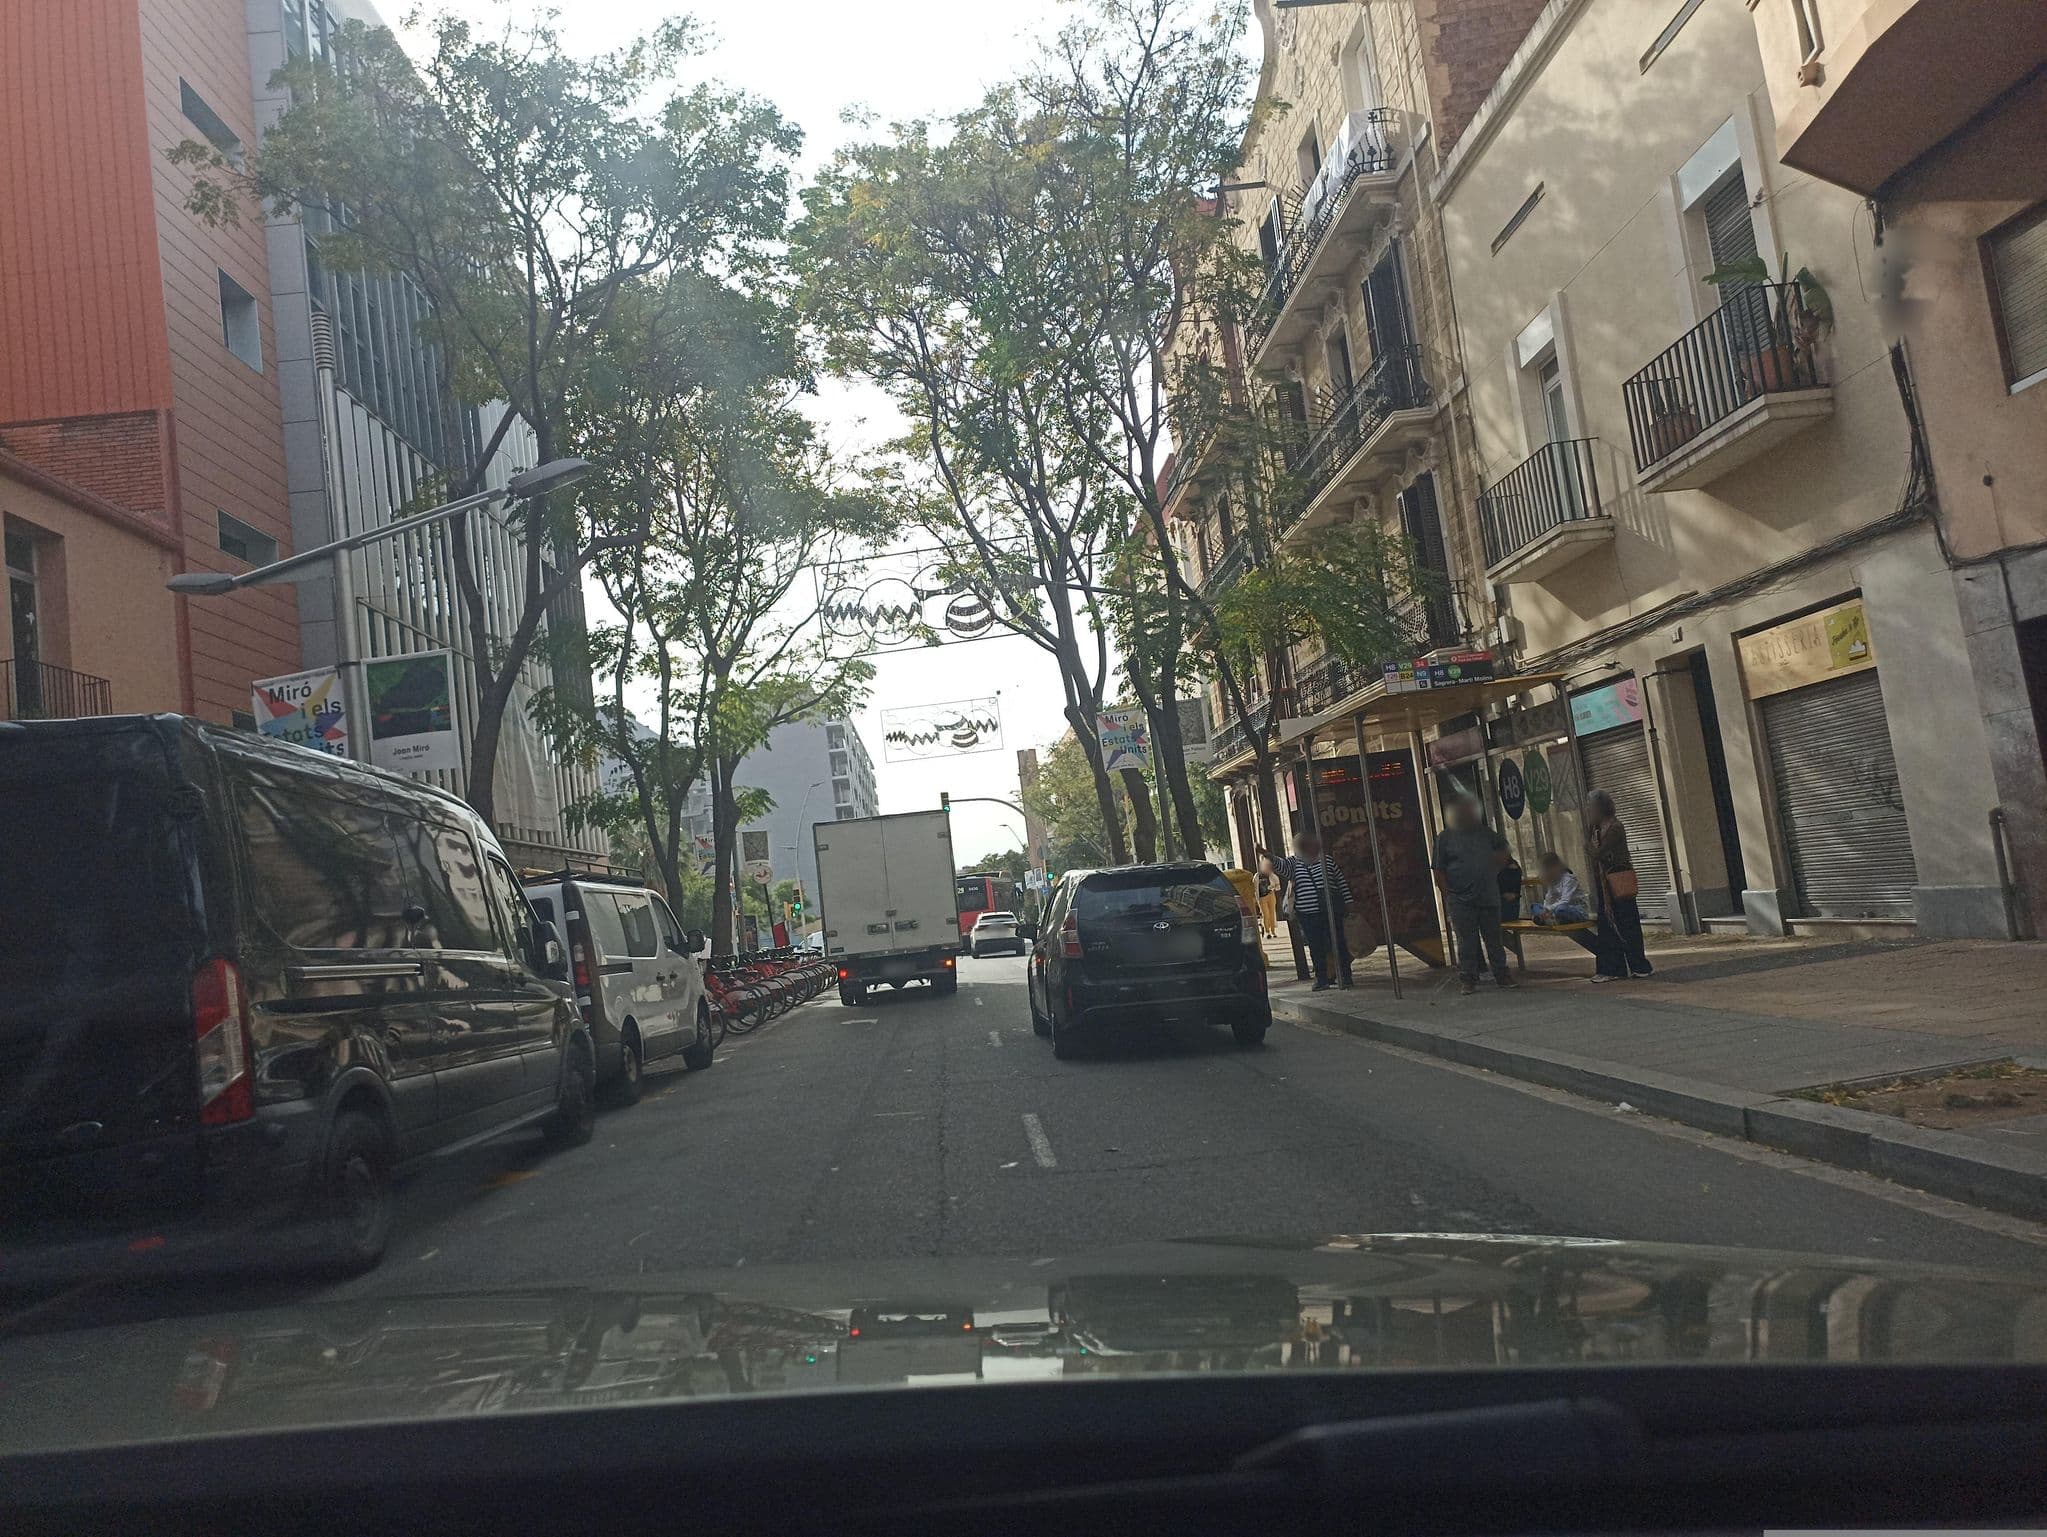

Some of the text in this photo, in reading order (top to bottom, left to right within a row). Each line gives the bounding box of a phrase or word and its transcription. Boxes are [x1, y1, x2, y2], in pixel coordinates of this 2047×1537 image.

[1744, 623, 1822, 667] ASTISSERIA
[1385, 662, 1412, 671] H8 V29
[269, 681, 312, 704] Miró
[300, 698, 342, 719] i els
[1105, 714, 1129, 723] Miró
[1129, 722, 1145, 731] els
[262, 722, 324, 742] tats
[1102, 734, 1137, 748] Estats
[1120, 744, 1148, 754] Units
[392, 744, 430, 756] Joan Miró
[1502, 775, 1521, 800] H8
[1525, 767, 1549, 793] V29
